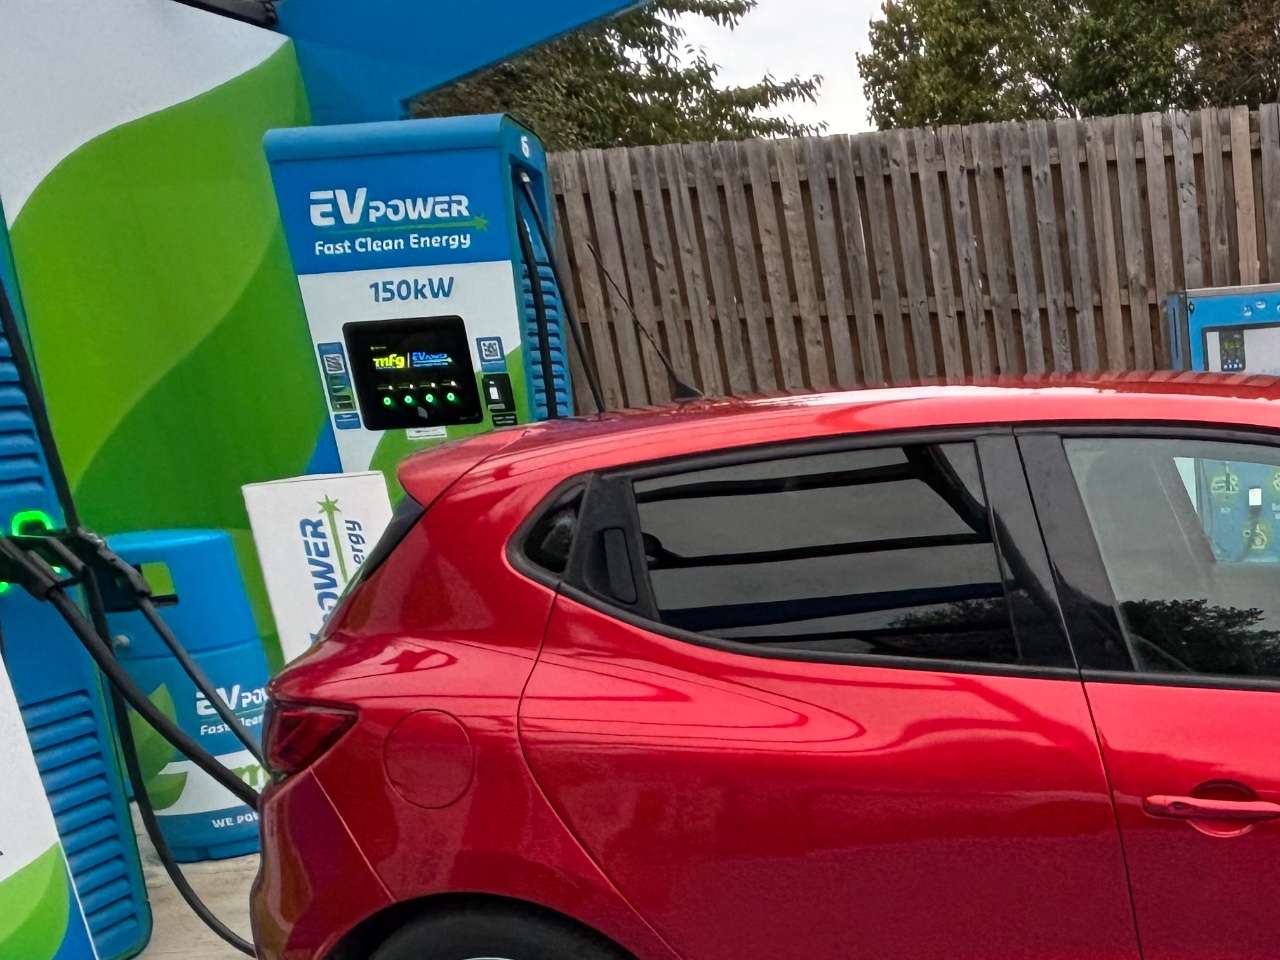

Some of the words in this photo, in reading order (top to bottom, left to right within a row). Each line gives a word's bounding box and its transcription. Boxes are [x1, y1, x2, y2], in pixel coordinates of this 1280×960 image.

[309, 187, 367, 227] EV
[369, 194, 470, 223] POWER
[315, 241, 352, 256] Fast
[355, 237, 404, 252] Clean
[409, 233, 471, 249] Energy
[369, 276, 455, 303] 150kW
[344, 519, 366, 567] ergy
[299, 517, 340, 625] OWER
[212, 817, 234, 829] WE
